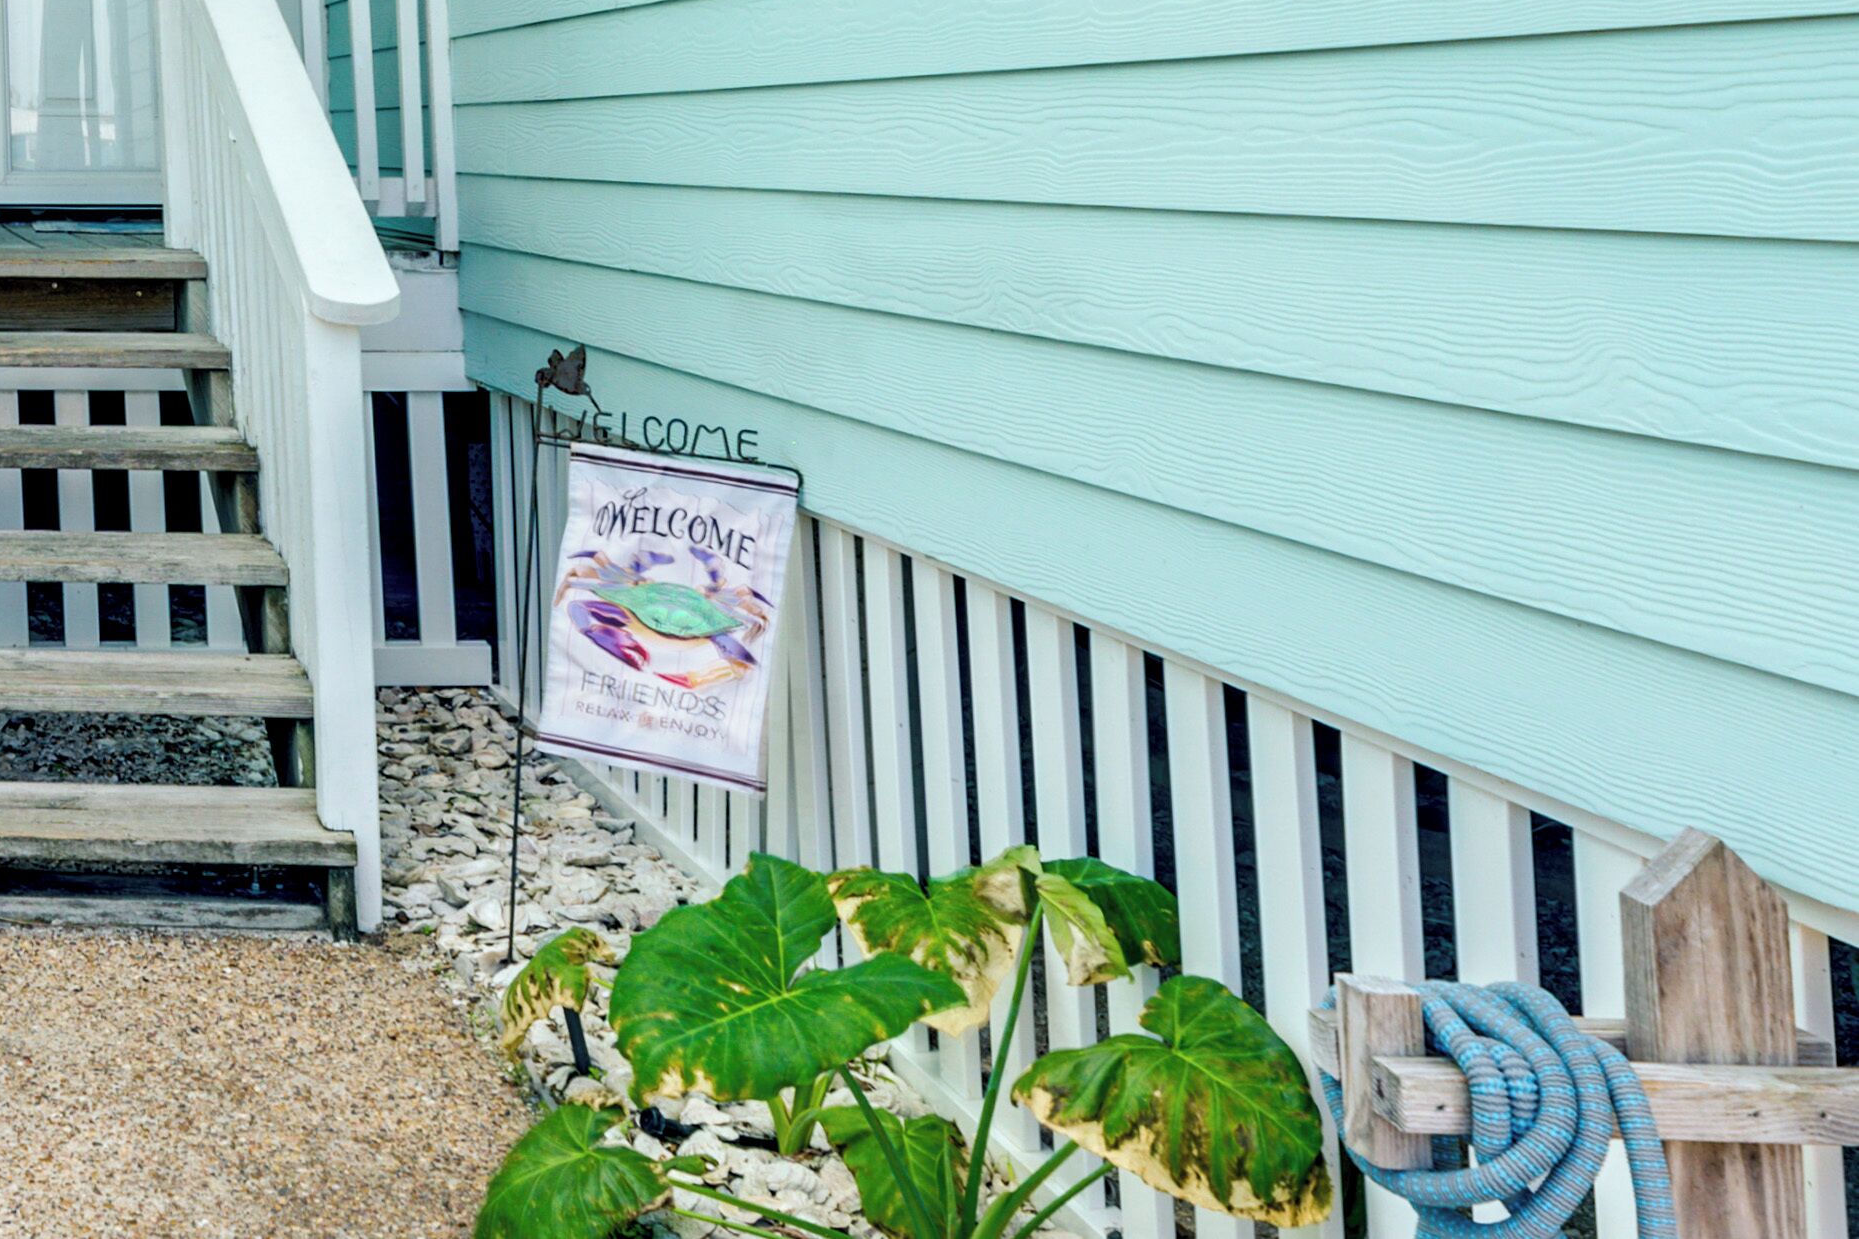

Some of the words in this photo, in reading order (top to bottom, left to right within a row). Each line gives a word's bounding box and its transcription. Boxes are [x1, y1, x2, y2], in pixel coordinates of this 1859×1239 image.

[547, 407, 758, 461] WELCOME
[594, 488, 756, 570] WELCOME
[575, 700, 631, 722] RELAX
[659, 717, 727, 740] ENJOY
[580, 671, 726, 719] FRIENDS
